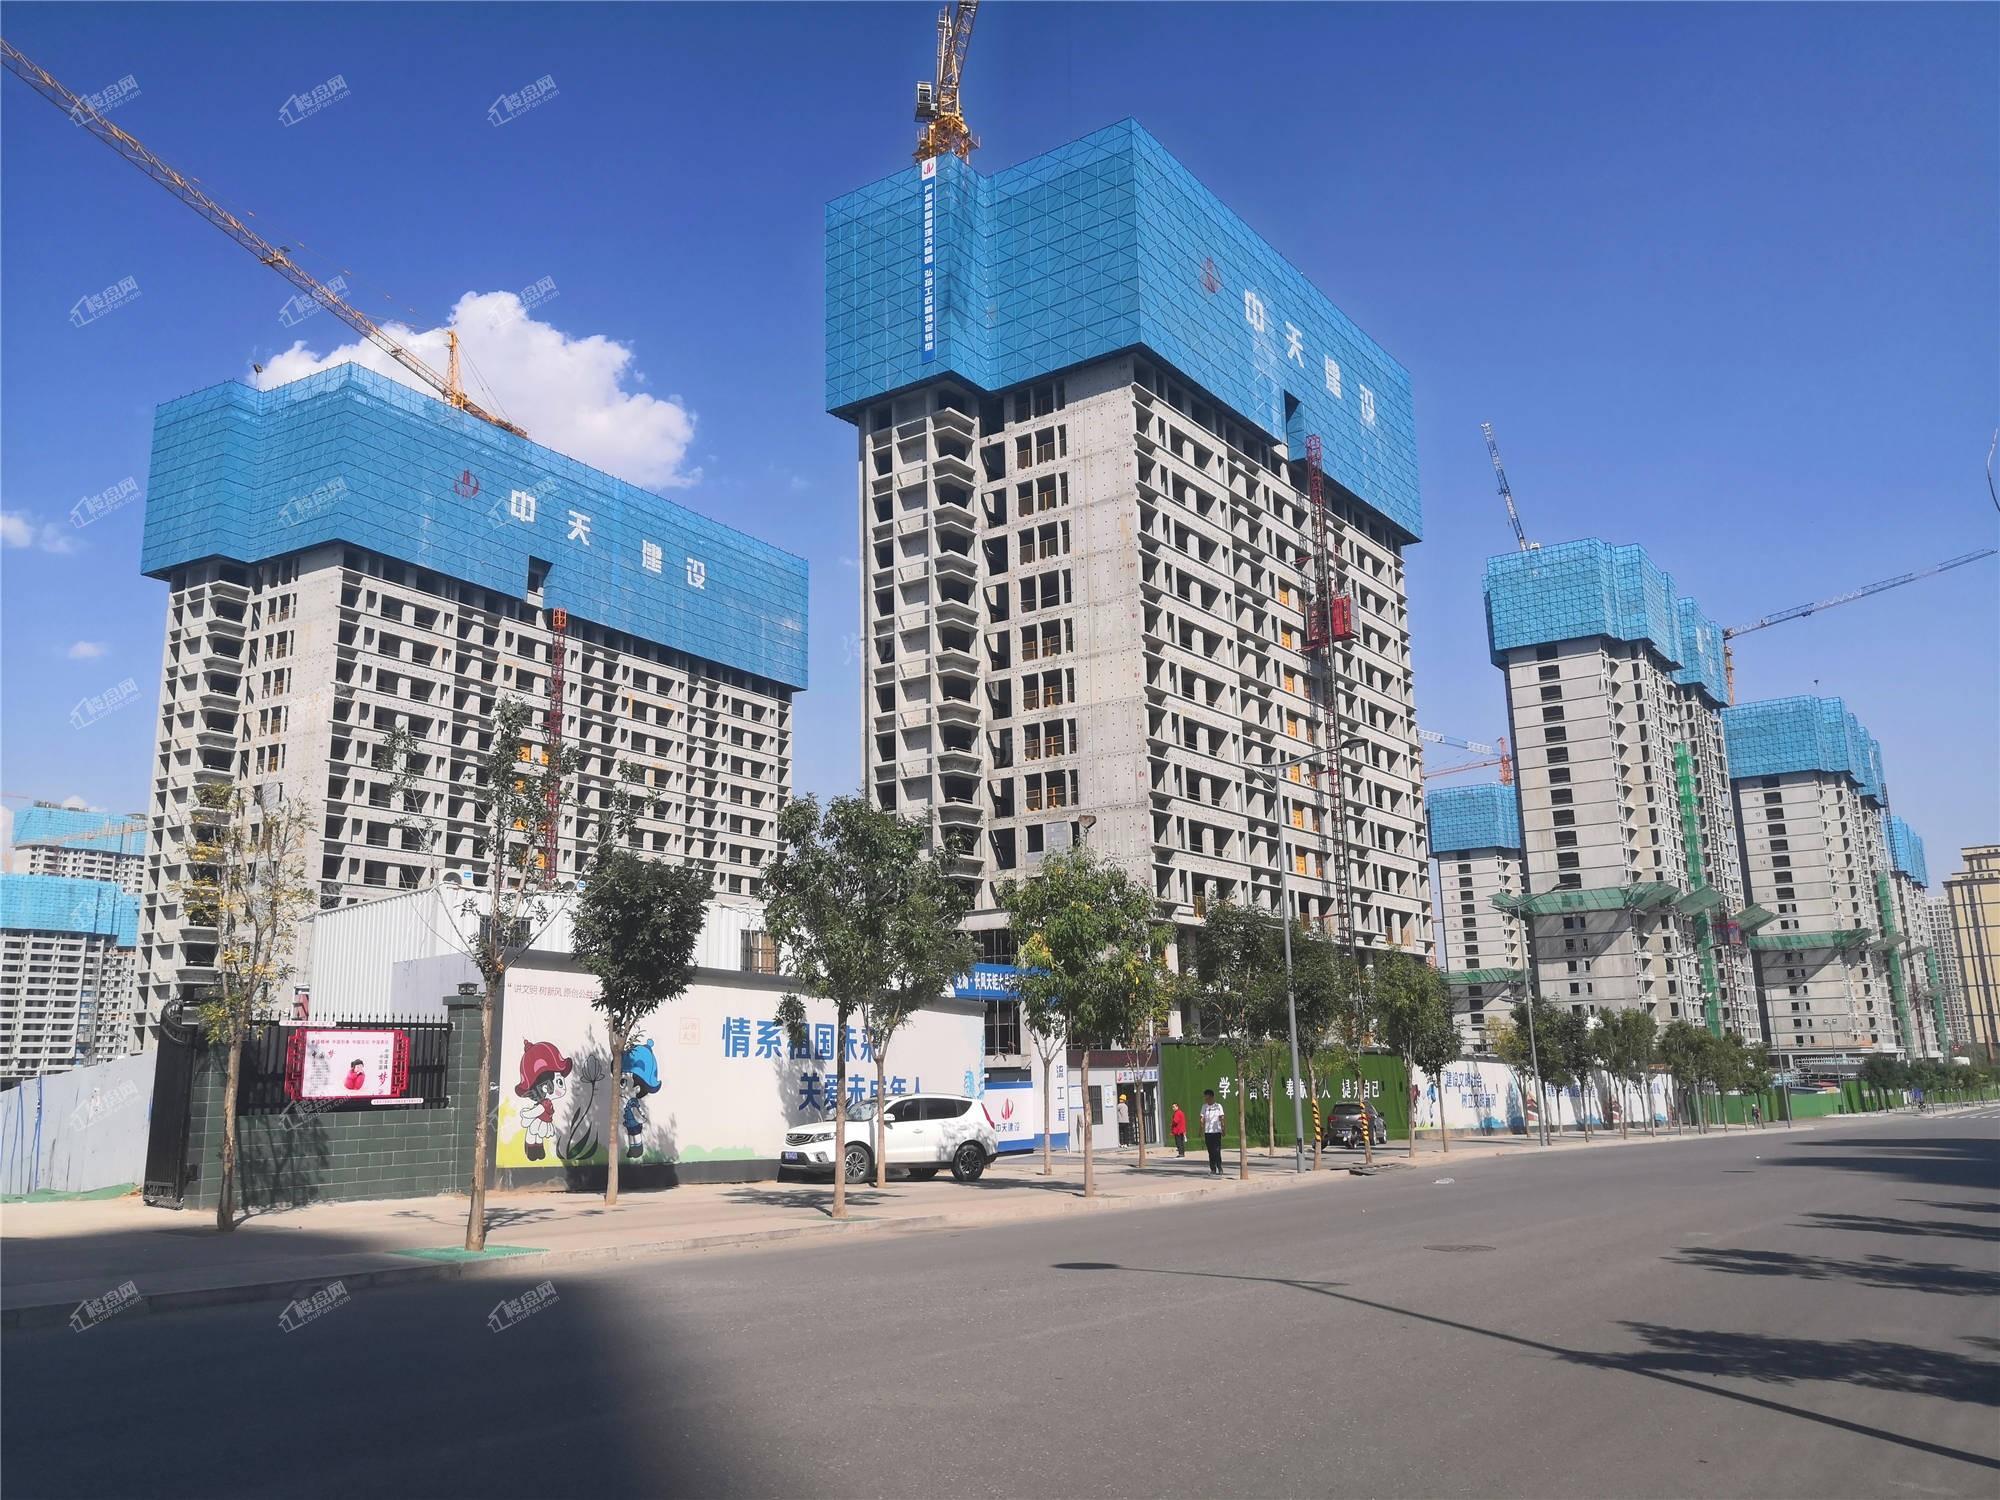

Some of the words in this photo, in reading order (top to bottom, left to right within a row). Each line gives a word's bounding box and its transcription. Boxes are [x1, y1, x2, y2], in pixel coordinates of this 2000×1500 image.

[1244, 289, 1376, 426] 中天建设
[510, 489, 706, 590] 中天建设
[539, 986, 563, 997] 树新风
[1286, 1078, 1330, 1099] 奉献人
